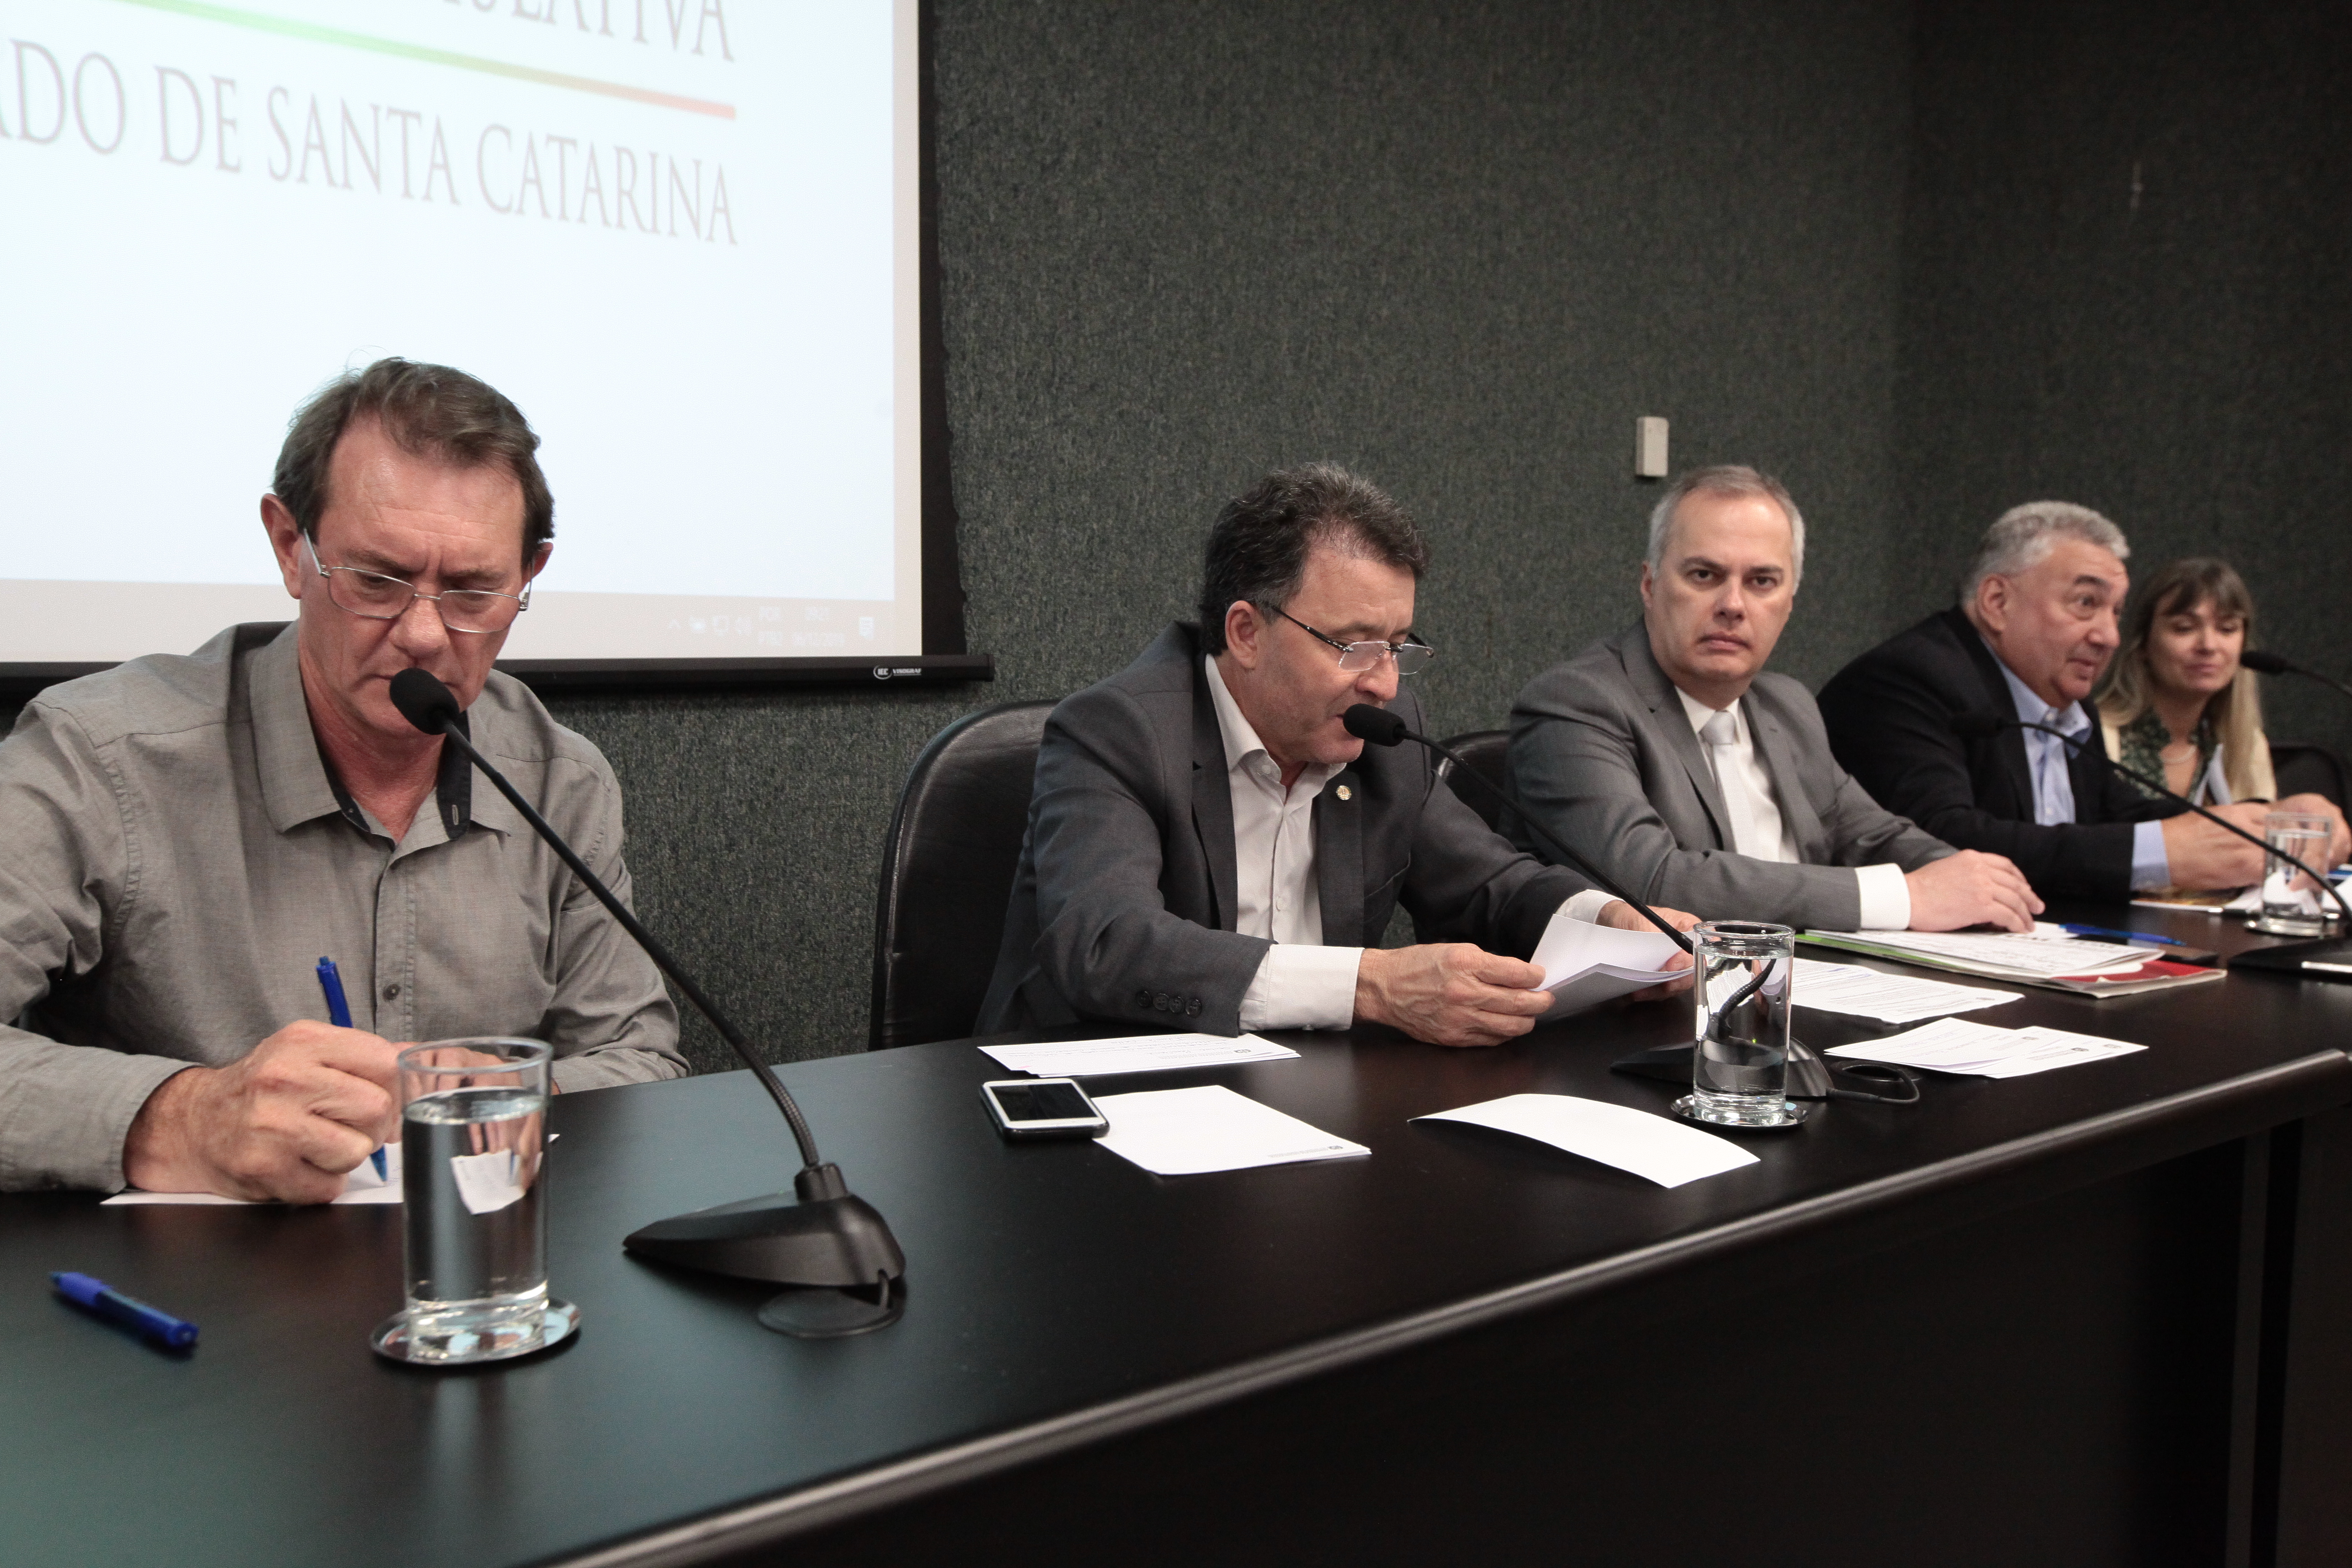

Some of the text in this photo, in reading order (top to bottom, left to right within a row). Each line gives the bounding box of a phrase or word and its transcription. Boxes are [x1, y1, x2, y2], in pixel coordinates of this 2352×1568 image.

[0, 38, 738, 245] DO DE SANTA CATARINA
